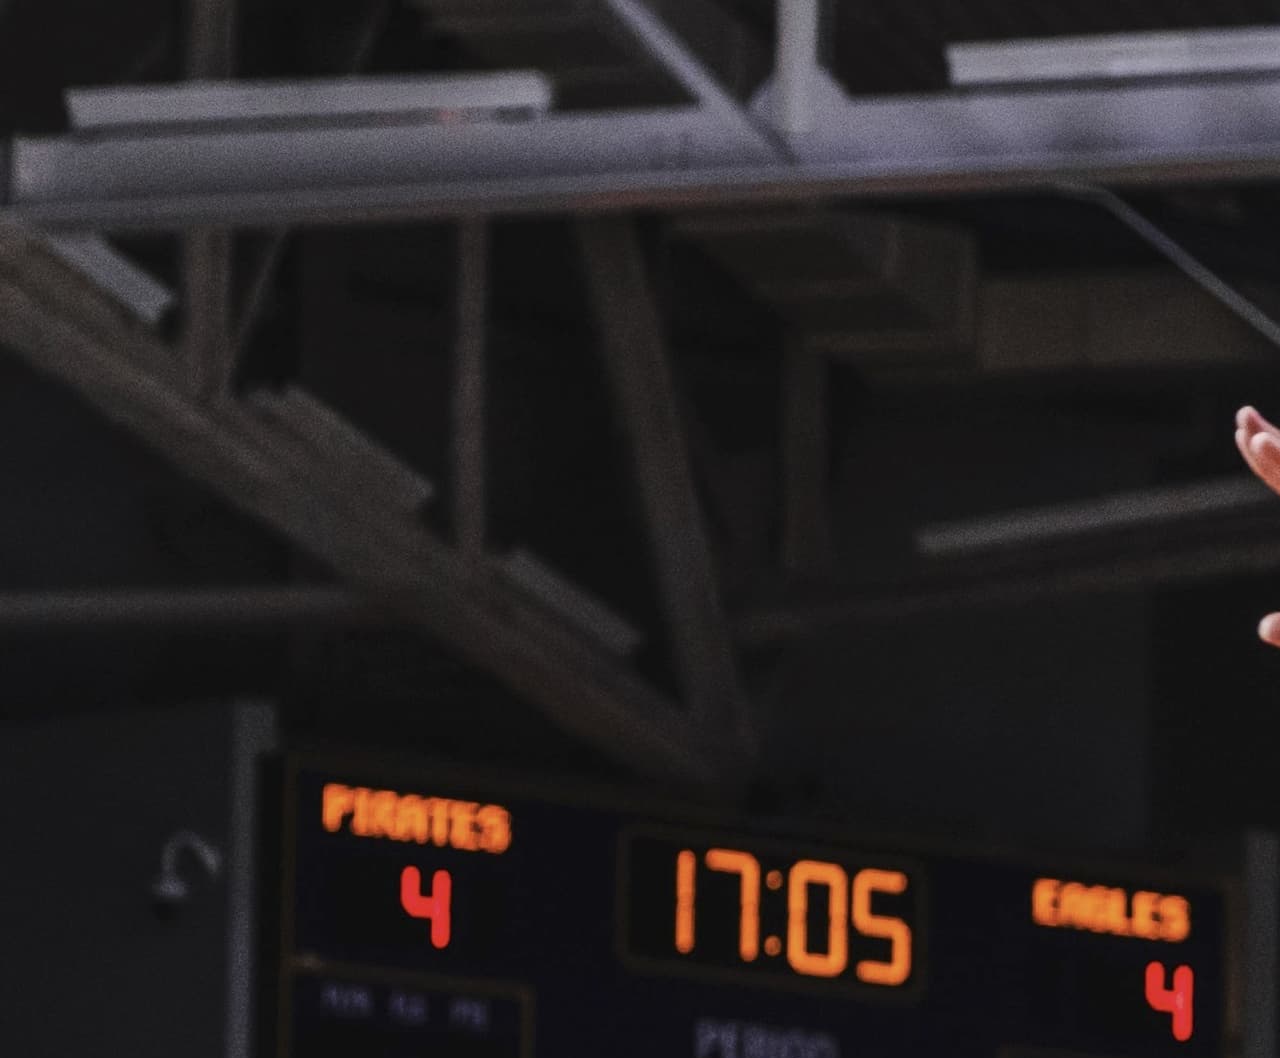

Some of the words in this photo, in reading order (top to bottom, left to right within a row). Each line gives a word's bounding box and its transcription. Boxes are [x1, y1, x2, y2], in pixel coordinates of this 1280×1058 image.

[321, 782, 513, 854] PIRATES
[400, 865, 453, 950] 4
[674, 848, 913, 986] 17:05
[1031, 877, 1193, 943] EAGLES
[1144, 960, 1195, 1043] 4
